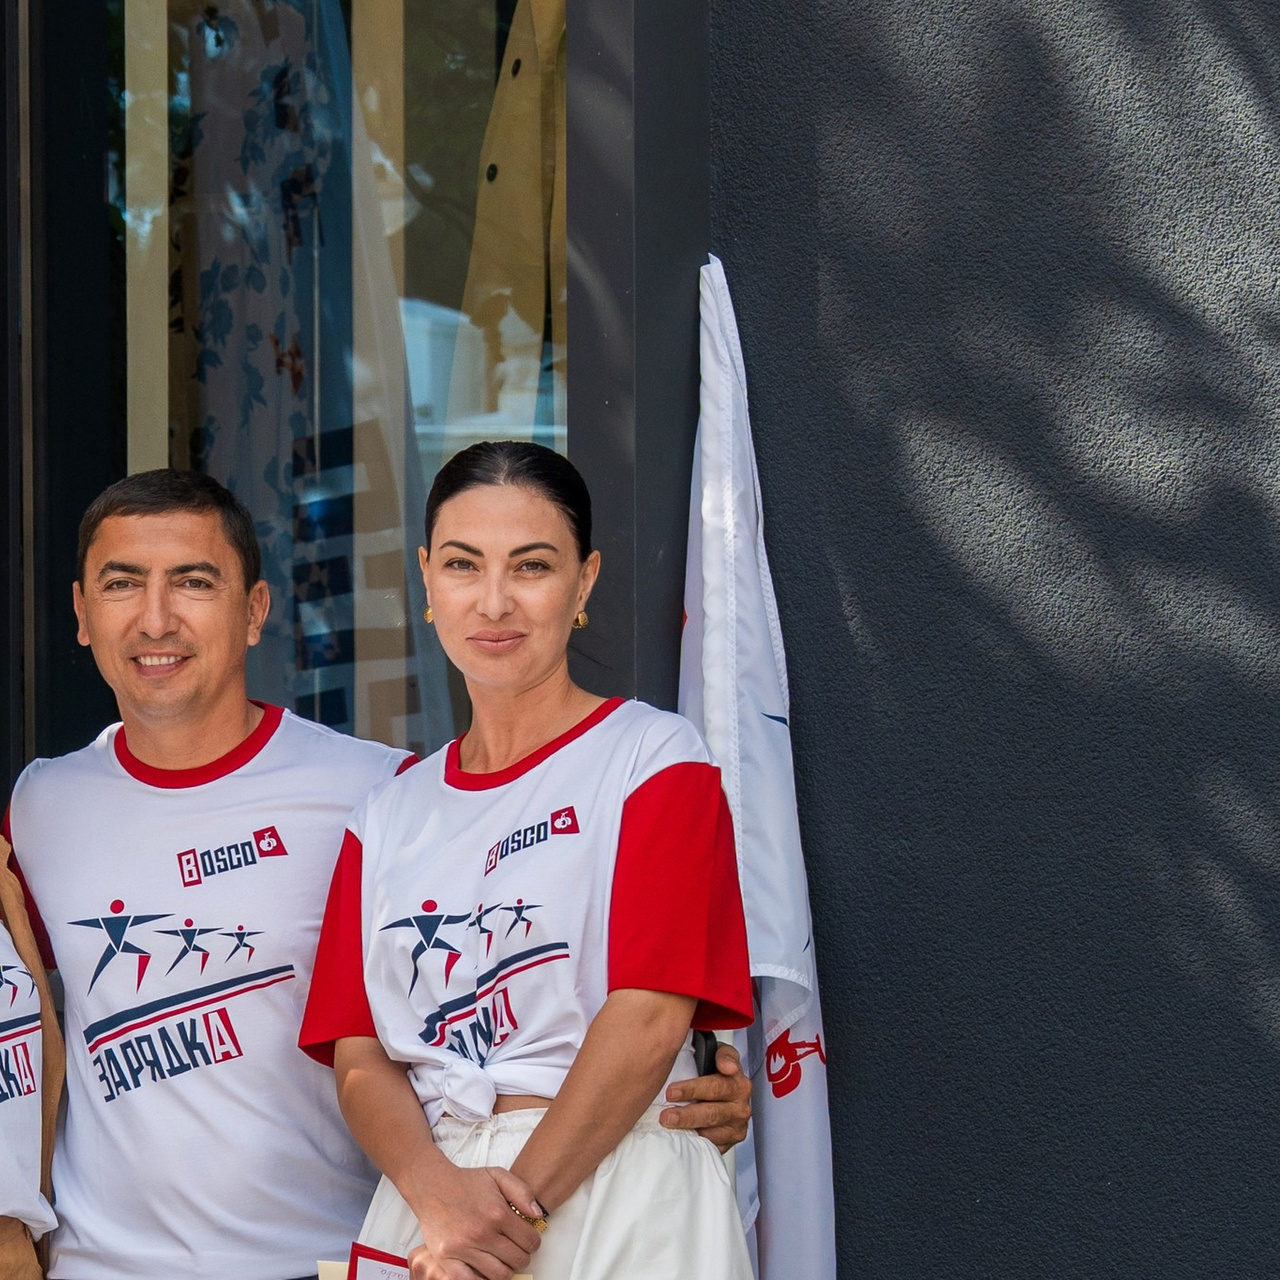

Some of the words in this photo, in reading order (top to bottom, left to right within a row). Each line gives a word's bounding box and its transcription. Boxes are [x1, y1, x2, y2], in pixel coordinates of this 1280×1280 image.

[176, 841, 258, 887] BOSCO
[484, 821, 549, 876] BOSCO
[93, 1007, 244, 1103] ЗАРЯДКА
